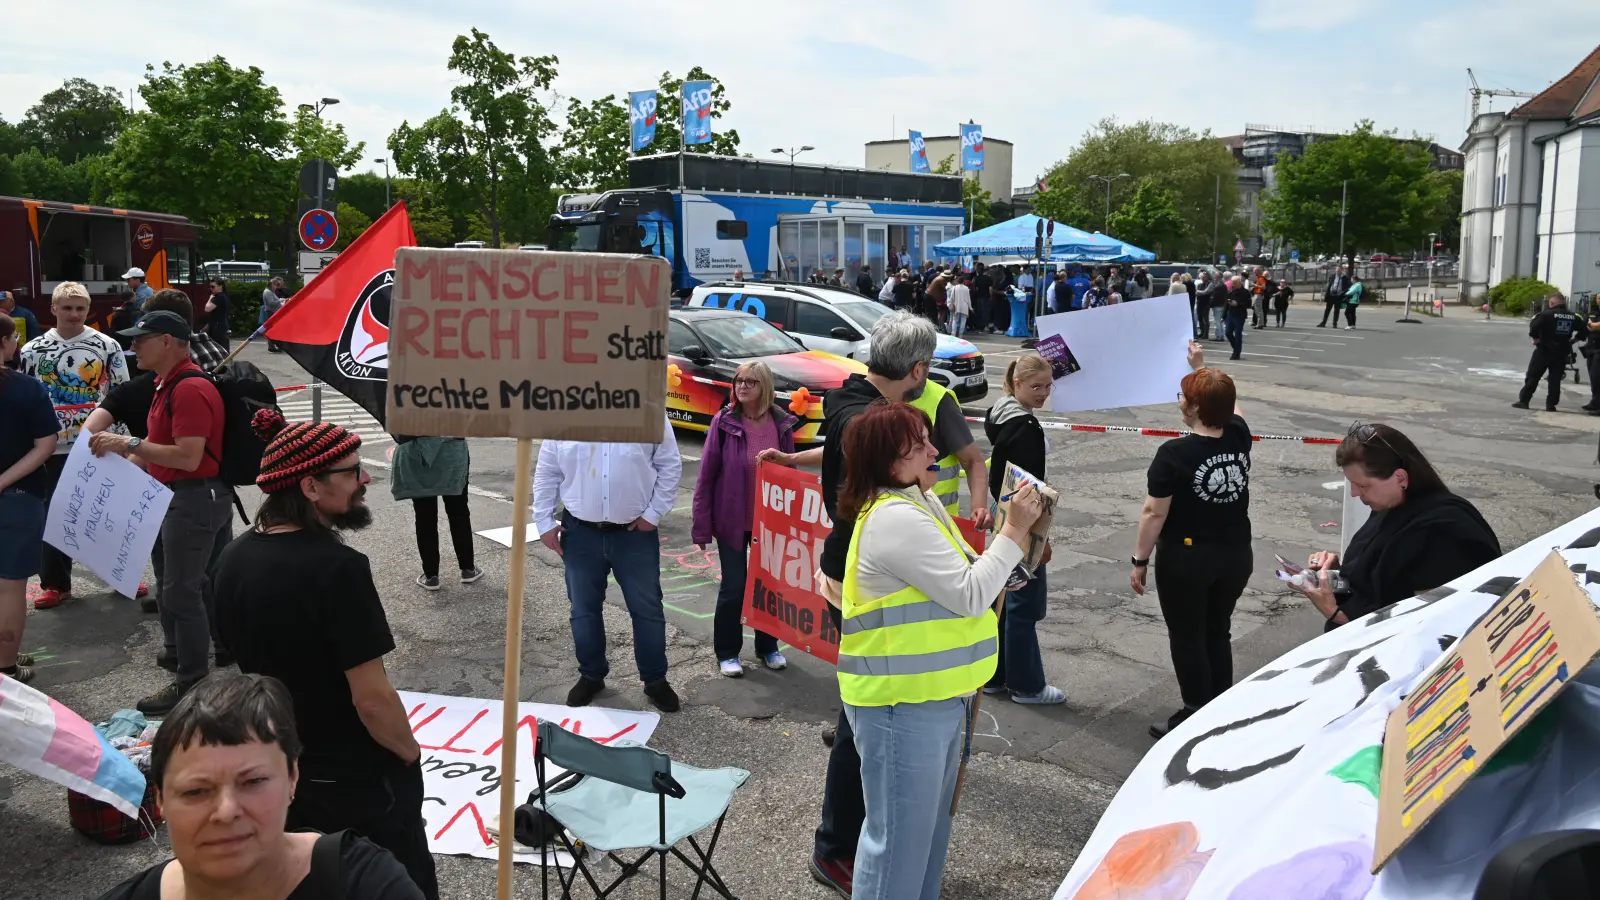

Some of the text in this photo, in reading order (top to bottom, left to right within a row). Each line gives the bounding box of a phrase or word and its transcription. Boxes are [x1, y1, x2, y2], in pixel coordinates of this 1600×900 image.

[632, 98, 656, 124] AfD
[683, 89, 711, 116] AfD
[910, 137, 925, 154] AfD
[962, 131, 983, 149] AfD
[402, 257, 660, 308] MENSCHEN
[397, 306, 665, 363] RECHTE statt
[339, 351, 372, 377] AKTION
[393, 378, 641, 410] rechte Menschen
[666, 391, 690, 402] enburg
[1193, 463, 1209, 484] HIRN
[1206, 453, 1235, 467] GEGEN
[63, 525, 80, 551] DIE
[78, 461, 97, 484] DES
[83, 477, 115, 543] MENSCHEN
[104, 512, 115, 533] IST
[752, 577, 813, 636] keine
